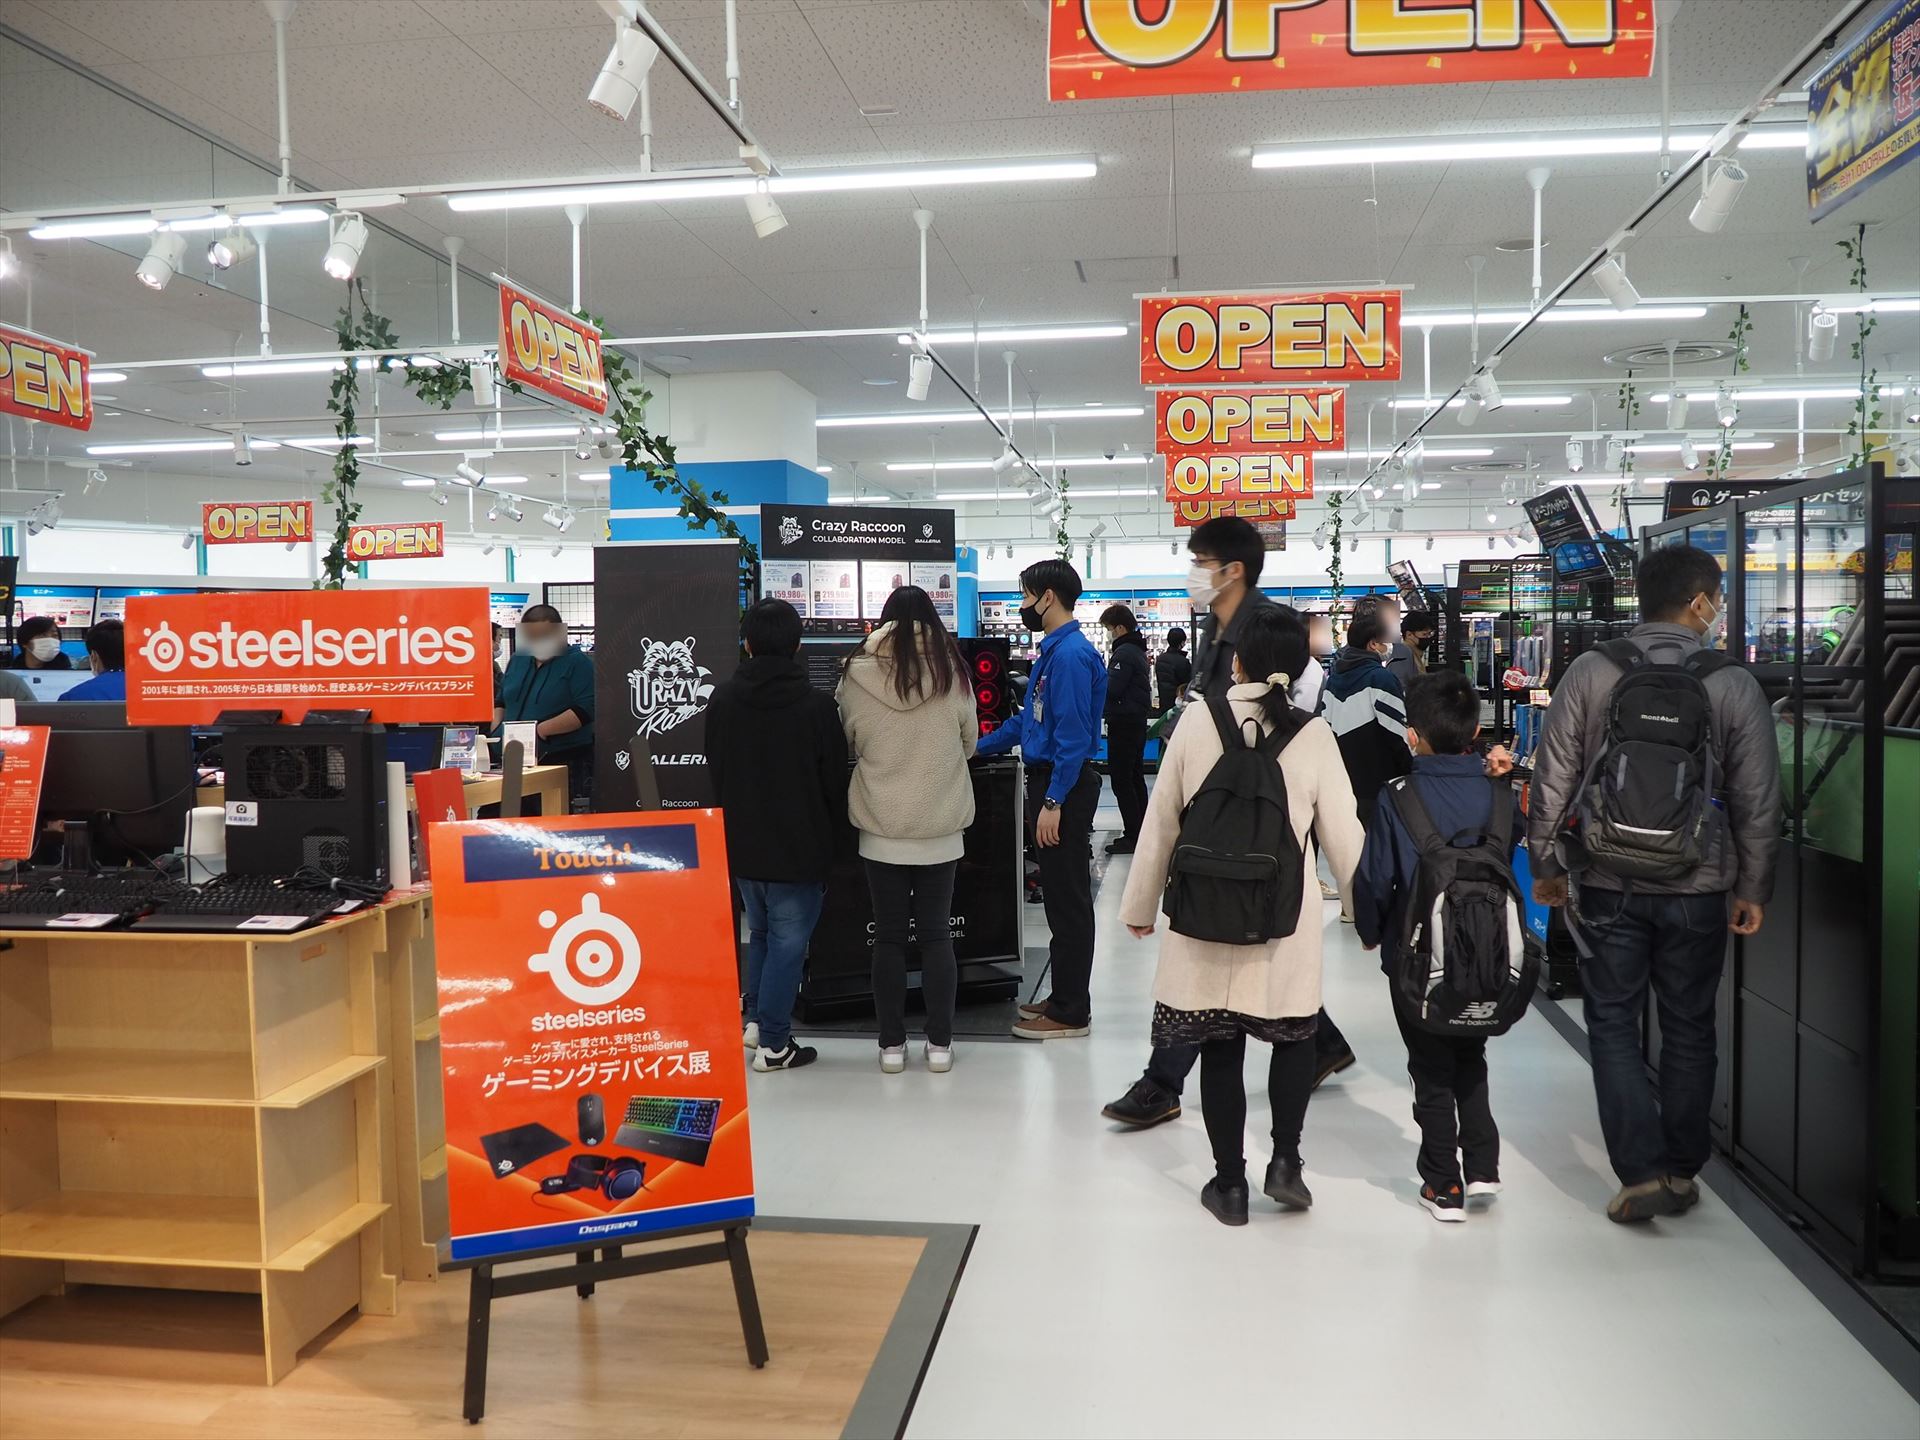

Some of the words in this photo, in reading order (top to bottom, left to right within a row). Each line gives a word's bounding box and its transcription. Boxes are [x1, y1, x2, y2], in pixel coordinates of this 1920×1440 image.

[510, 300, 603, 400] OPEN
[1155, 302, 1385, 370] OPEN
[0, 338, 84, 418] EN
[1166, 394, 1334, 444] OPEN
[1173, 454, 1305, 495] OPEN
[208, 506, 306, 540] OPEN
[812, 519, 848, 533] Crazy
[851, 521, 906, 533] Raccoon
[812, 536, 877, 544] COLLABORATION
[352, 526, 438, 557] OPEN
[189, 615, 475, 667] steelseries
[949, 930, 965, 938] DEL
[531, 1005, 646, 1032] steelseries
[503, 1048, 627, 1067] ゲーミングデバイスメーカー
[630, 1040, 689, 1054] SteelSeries
[481, 1050, 711, 1098] ゲーミングデバイス展
[578, 1220, 639, 1235] Dospara
